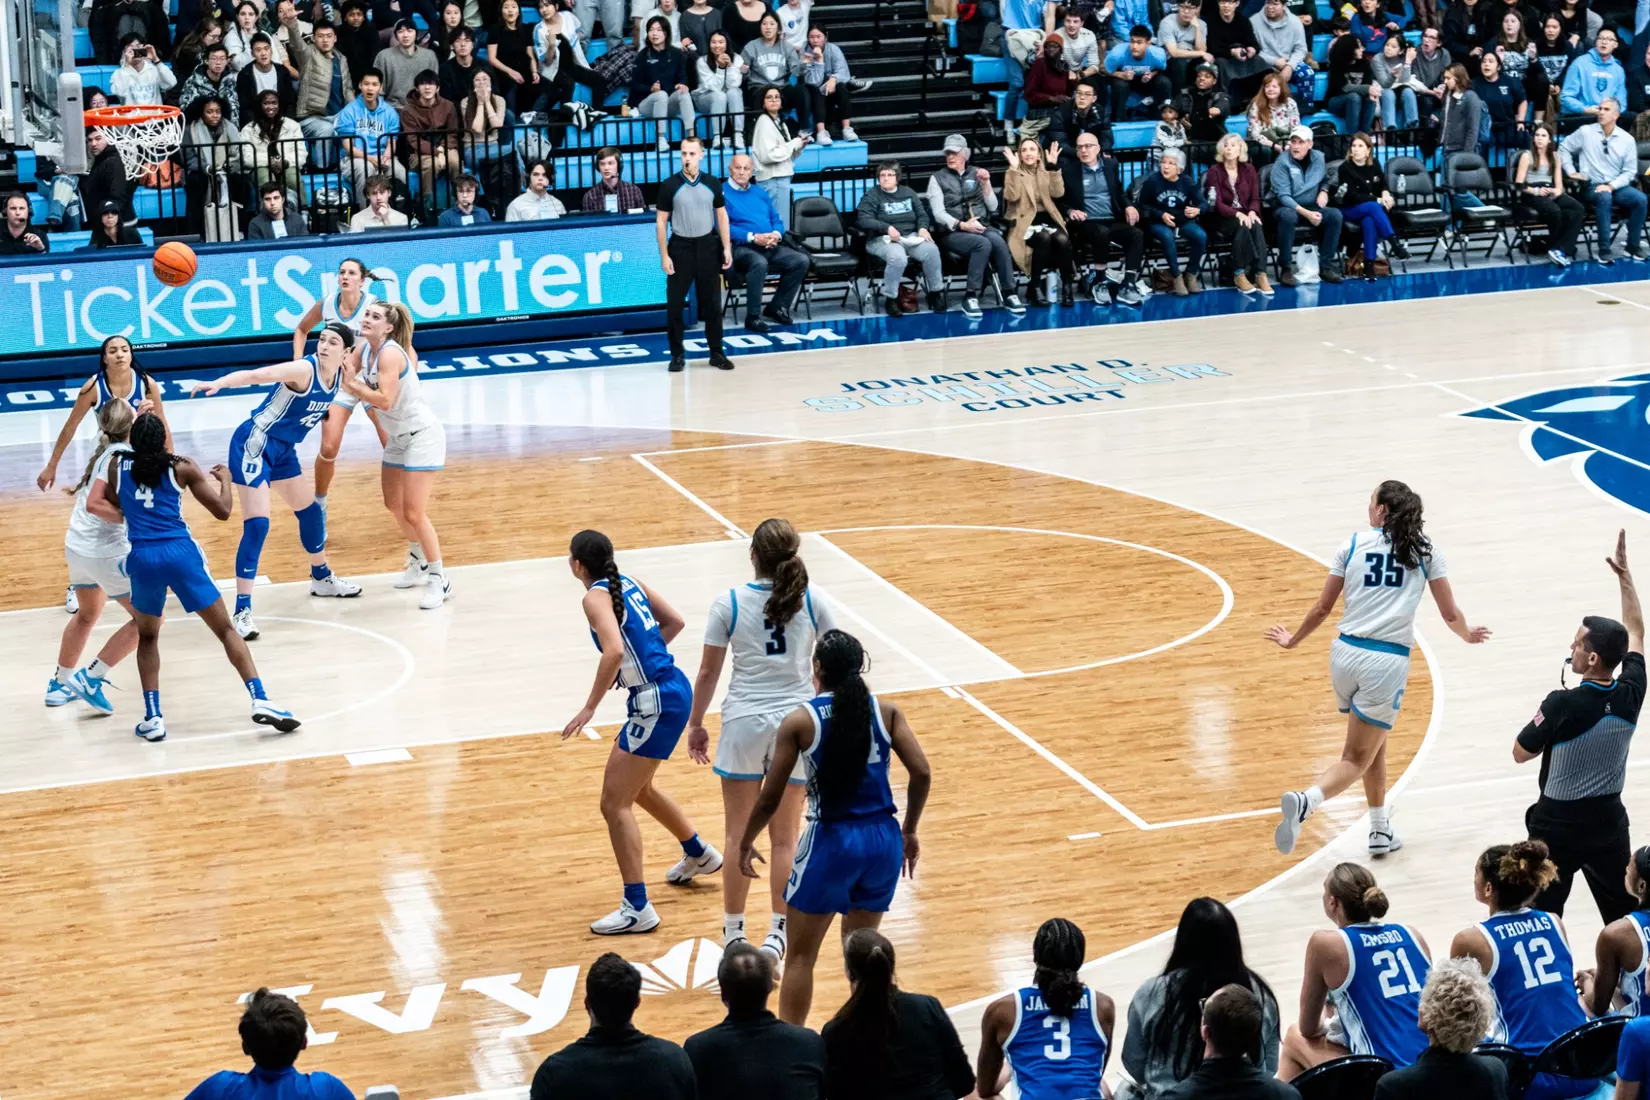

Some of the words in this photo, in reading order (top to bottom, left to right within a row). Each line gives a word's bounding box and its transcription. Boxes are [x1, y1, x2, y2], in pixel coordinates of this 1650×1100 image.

[802, 362, 1234, 412] SCHILLER
[841, 362, 1088, 393] JONATHAN
[1097, 358, 1149, 370] D.
[306, 400, 331, 412] DUK
[961, 389, 1128, 412] COURT
[299, 412, 323, 427] 42
[135, 482, 155, 508] 4
[1364, 553, 1404, 588] 35
[627, 591, 656, 632] 15
[763, 618, 788, 656] 3
[1359, 929, 1403, 947] EMSBO
[1494, 916, 1551, 940] THOMAS
[1372, 947, 1422, 999] 21
[1513, 937, 1563, 989] 12
[1042, 1015, 1071, 1061] 3
